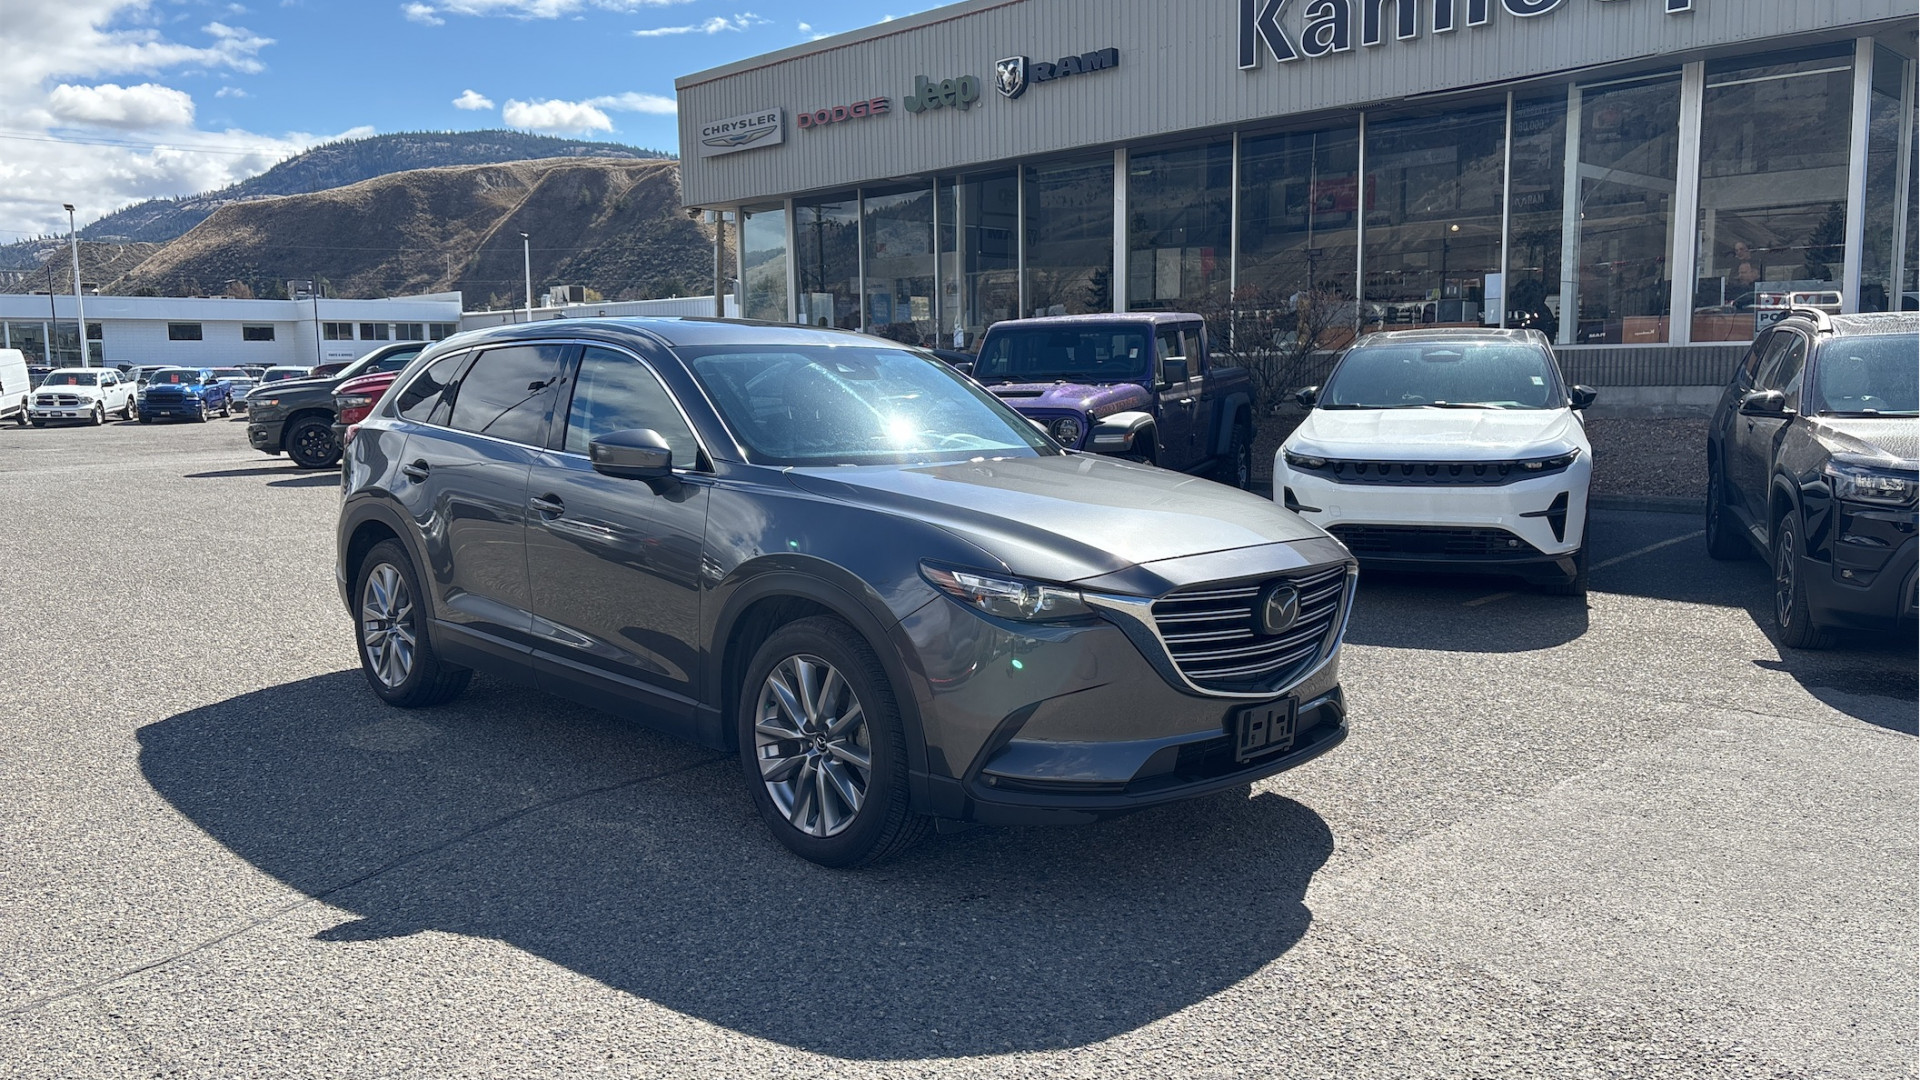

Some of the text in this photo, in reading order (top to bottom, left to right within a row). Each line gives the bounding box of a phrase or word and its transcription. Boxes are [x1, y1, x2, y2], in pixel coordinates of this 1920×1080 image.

[1030, 47, 1119, 83] RAM
[904, 75, 979, 113] Jeep
[702, 113, 776, 137] CHRYSLER
[797, 97, 891, 129] DODGE
